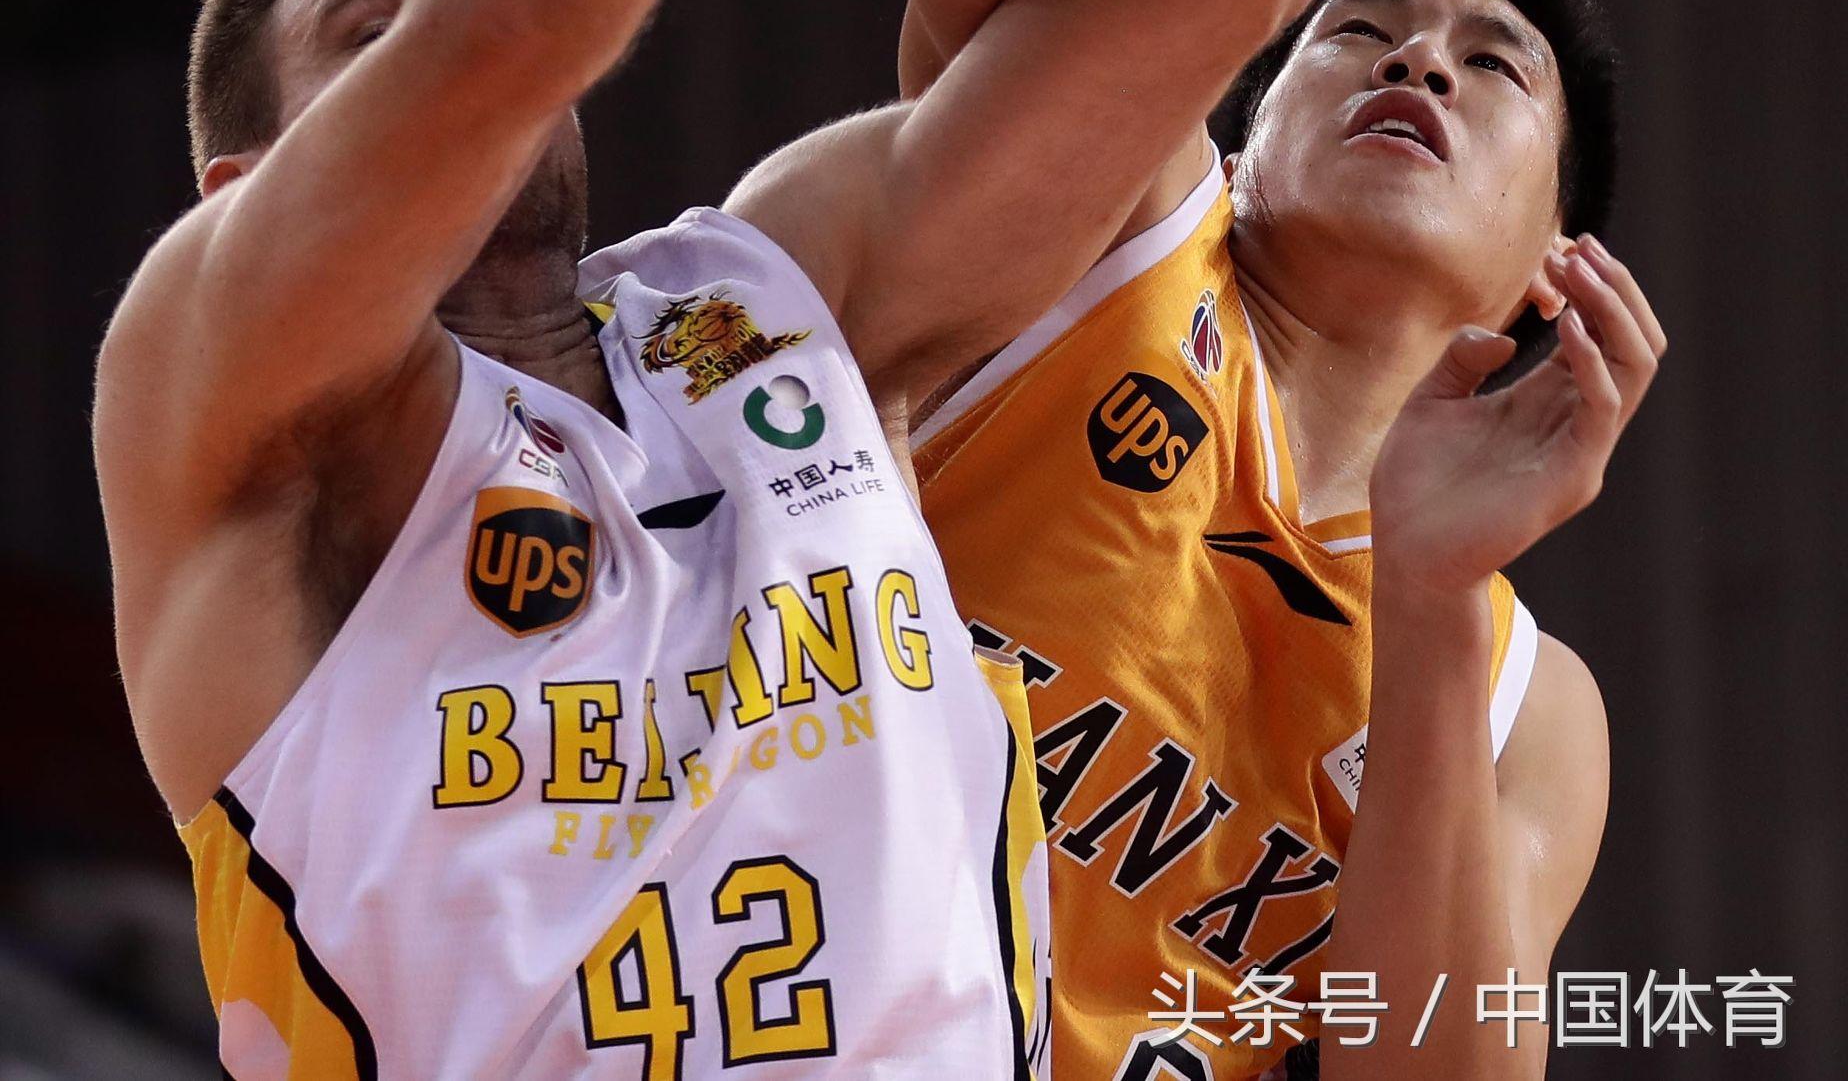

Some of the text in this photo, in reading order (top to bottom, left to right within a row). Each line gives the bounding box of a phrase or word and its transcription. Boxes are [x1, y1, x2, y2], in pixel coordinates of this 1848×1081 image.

[768, 449, 875, 498] 中国人寿
[786, 478, 885, 517] CHINA LIFE
[576, 854, 838, 1081] 42
